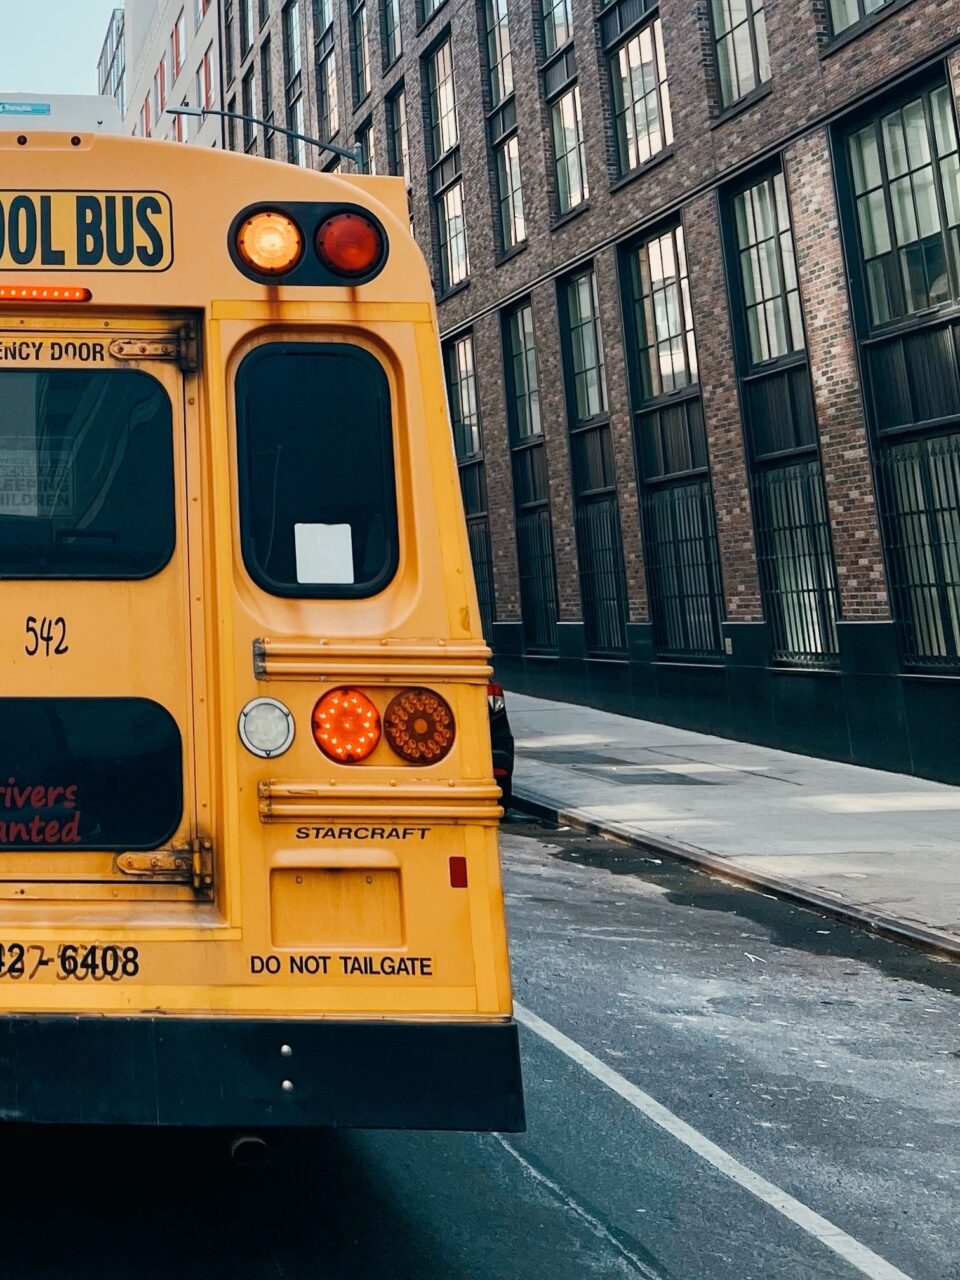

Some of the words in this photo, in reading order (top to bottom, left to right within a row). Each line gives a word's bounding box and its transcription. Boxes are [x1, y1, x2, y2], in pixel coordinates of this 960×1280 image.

[76, 195, 164, 267] BUS
[50, 341, 105, 362] DOOR
[25, 616, 69, 657] 542
[295, 826, 432, 840] STARCRAFT
[250, 955, 281, 975] DO
[289, 955, 331, 975] NOT
[339, 956, 433, 976] TAILGATE
